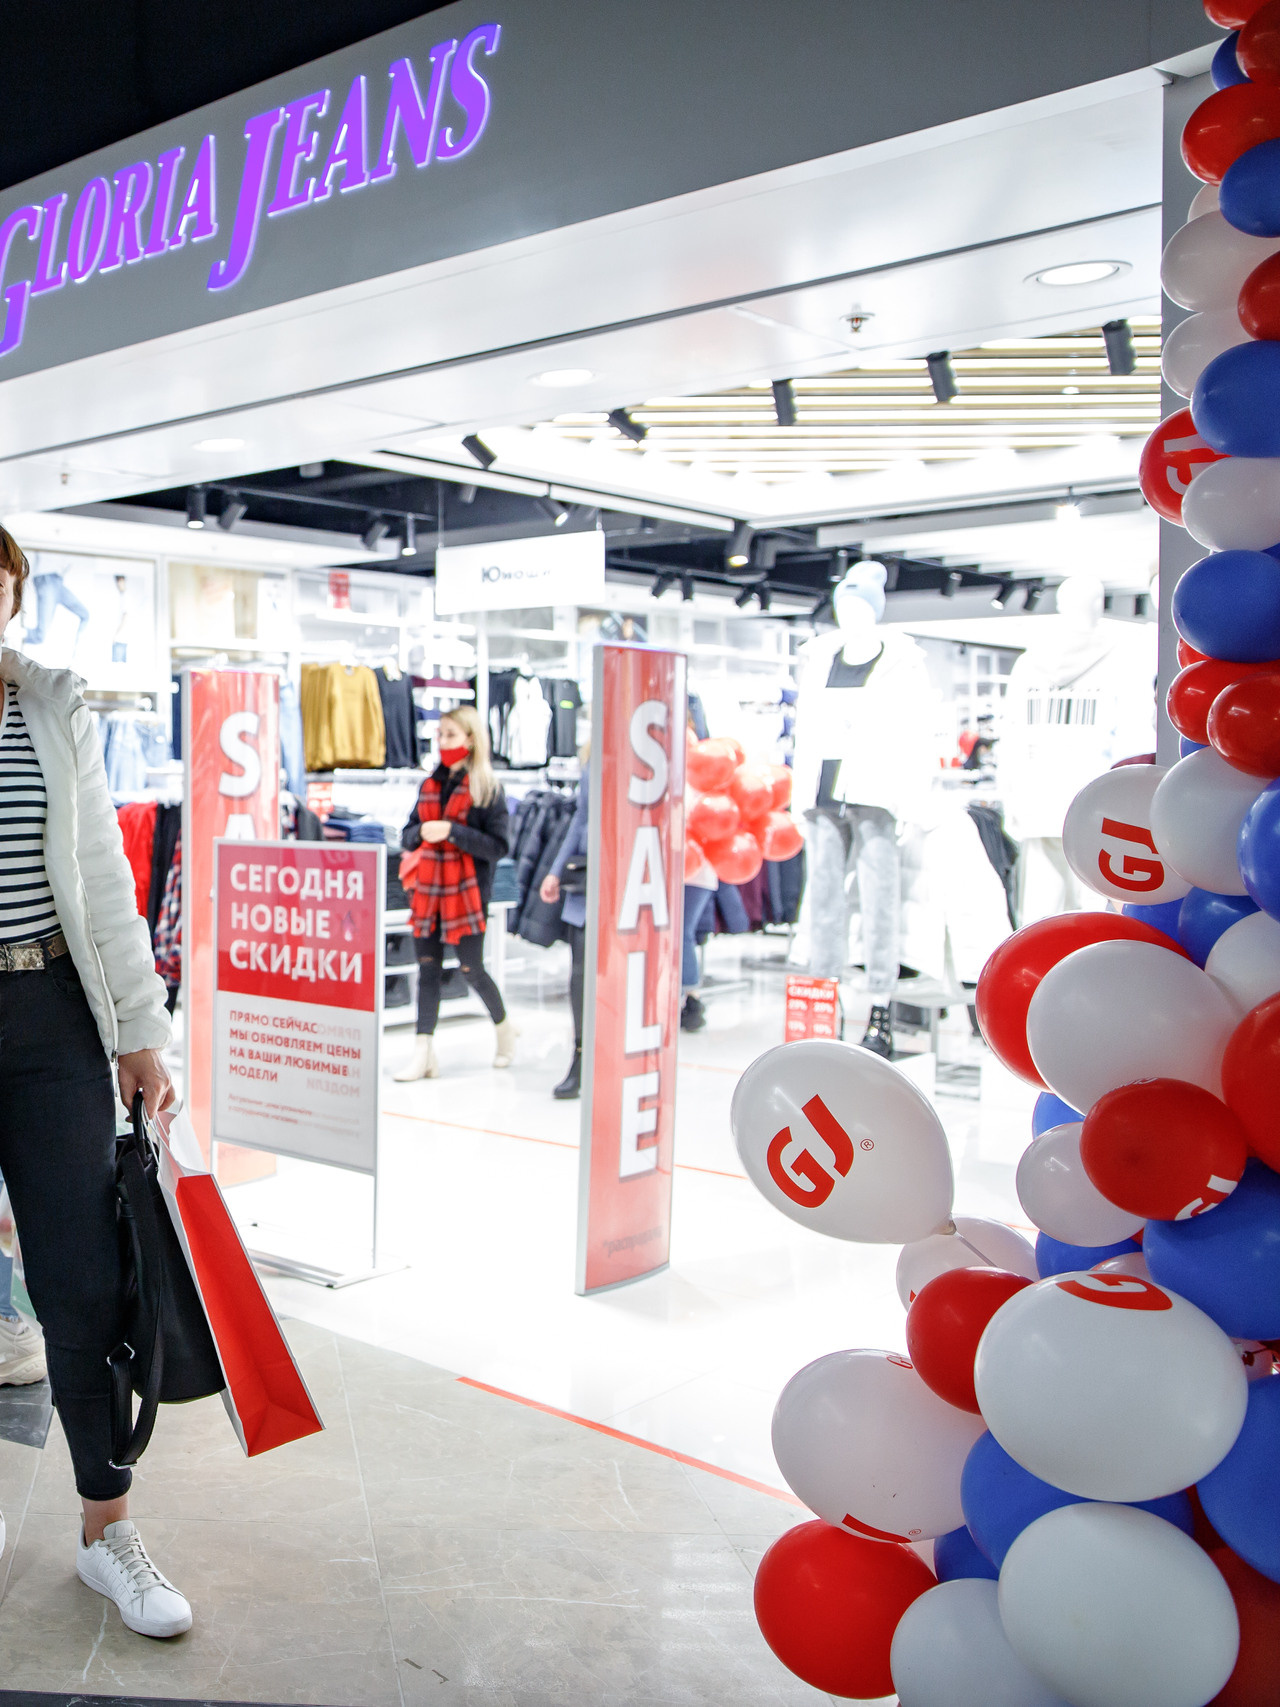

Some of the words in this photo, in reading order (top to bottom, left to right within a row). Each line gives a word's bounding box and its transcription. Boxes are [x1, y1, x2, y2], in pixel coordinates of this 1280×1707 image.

[206, 22, 502, 292] JEANS
[1098, 817, 1165, 892] GJ
[230, 862, 365, 902] СЕГОДНЯ
[230, 901, 332, 940] НОВЫЕ
[229, 939, 364, 984] СКИДКИ
[616, 700, 670, 1183] SALE
[229, 1010, 269, 1026] ПРЯМО
[272, 1015, 319, 1034] СЕЙЧАС
[229, 1028, 248, 1041] МЫ
[251, 1031, 323, 1053] ОБНОВЛЯЕМ
[326, 1044, 362, 1060] ЦЕНЫ
[229, 1046, 245, 1058] НА
[248, 1050, 281, 1065] ВАШИ
[284, 1055, 349, 1076] ЛЮБИМЫЕ
[229, 1063, 279, 1083] МОДЕЛИ
[767, 1093, 855, 1209] GJ
